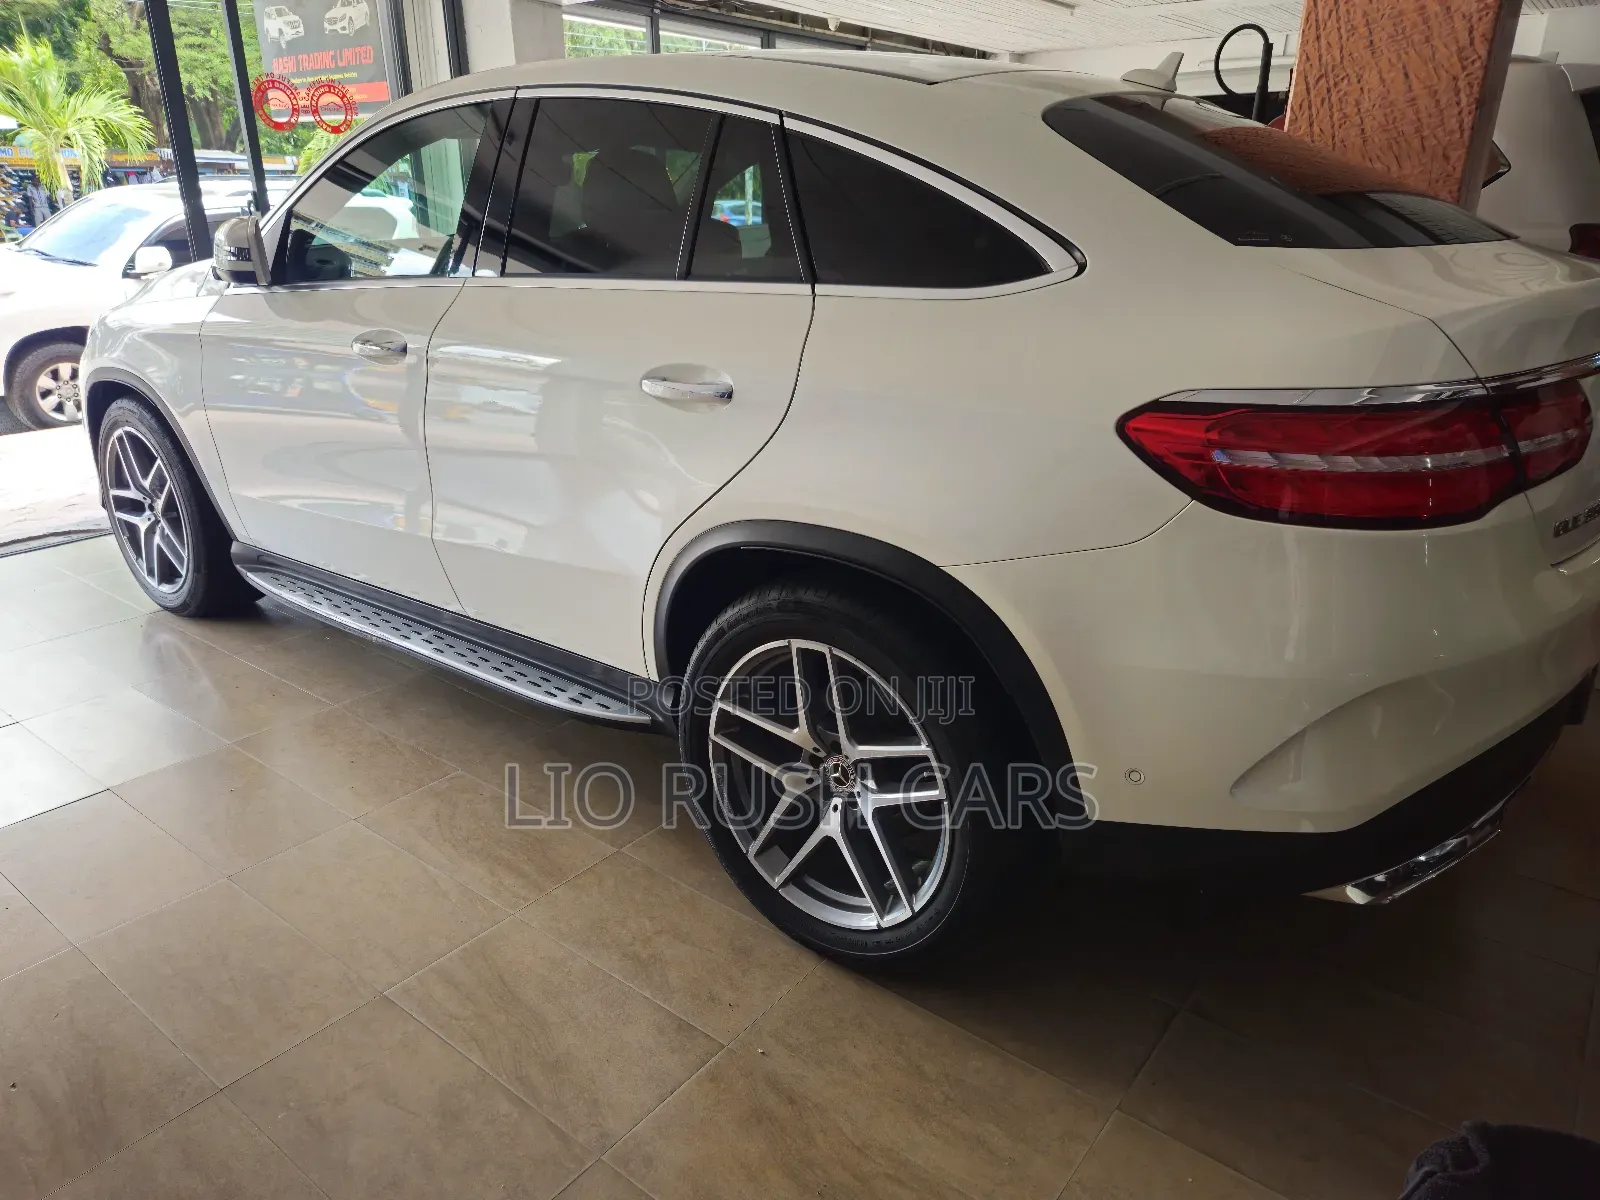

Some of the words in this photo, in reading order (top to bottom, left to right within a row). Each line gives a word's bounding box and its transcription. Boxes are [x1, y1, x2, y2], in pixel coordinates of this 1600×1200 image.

[298, 49, 335, 71] TRADING
[337, 45, 374, 67] LIMITED
[304, 77, 324, 102] CAREFUL
[327, 76, 336, 84] ON
[311, 85, 329, 110] TRADING
[330, 86, 343, 97] LTD
